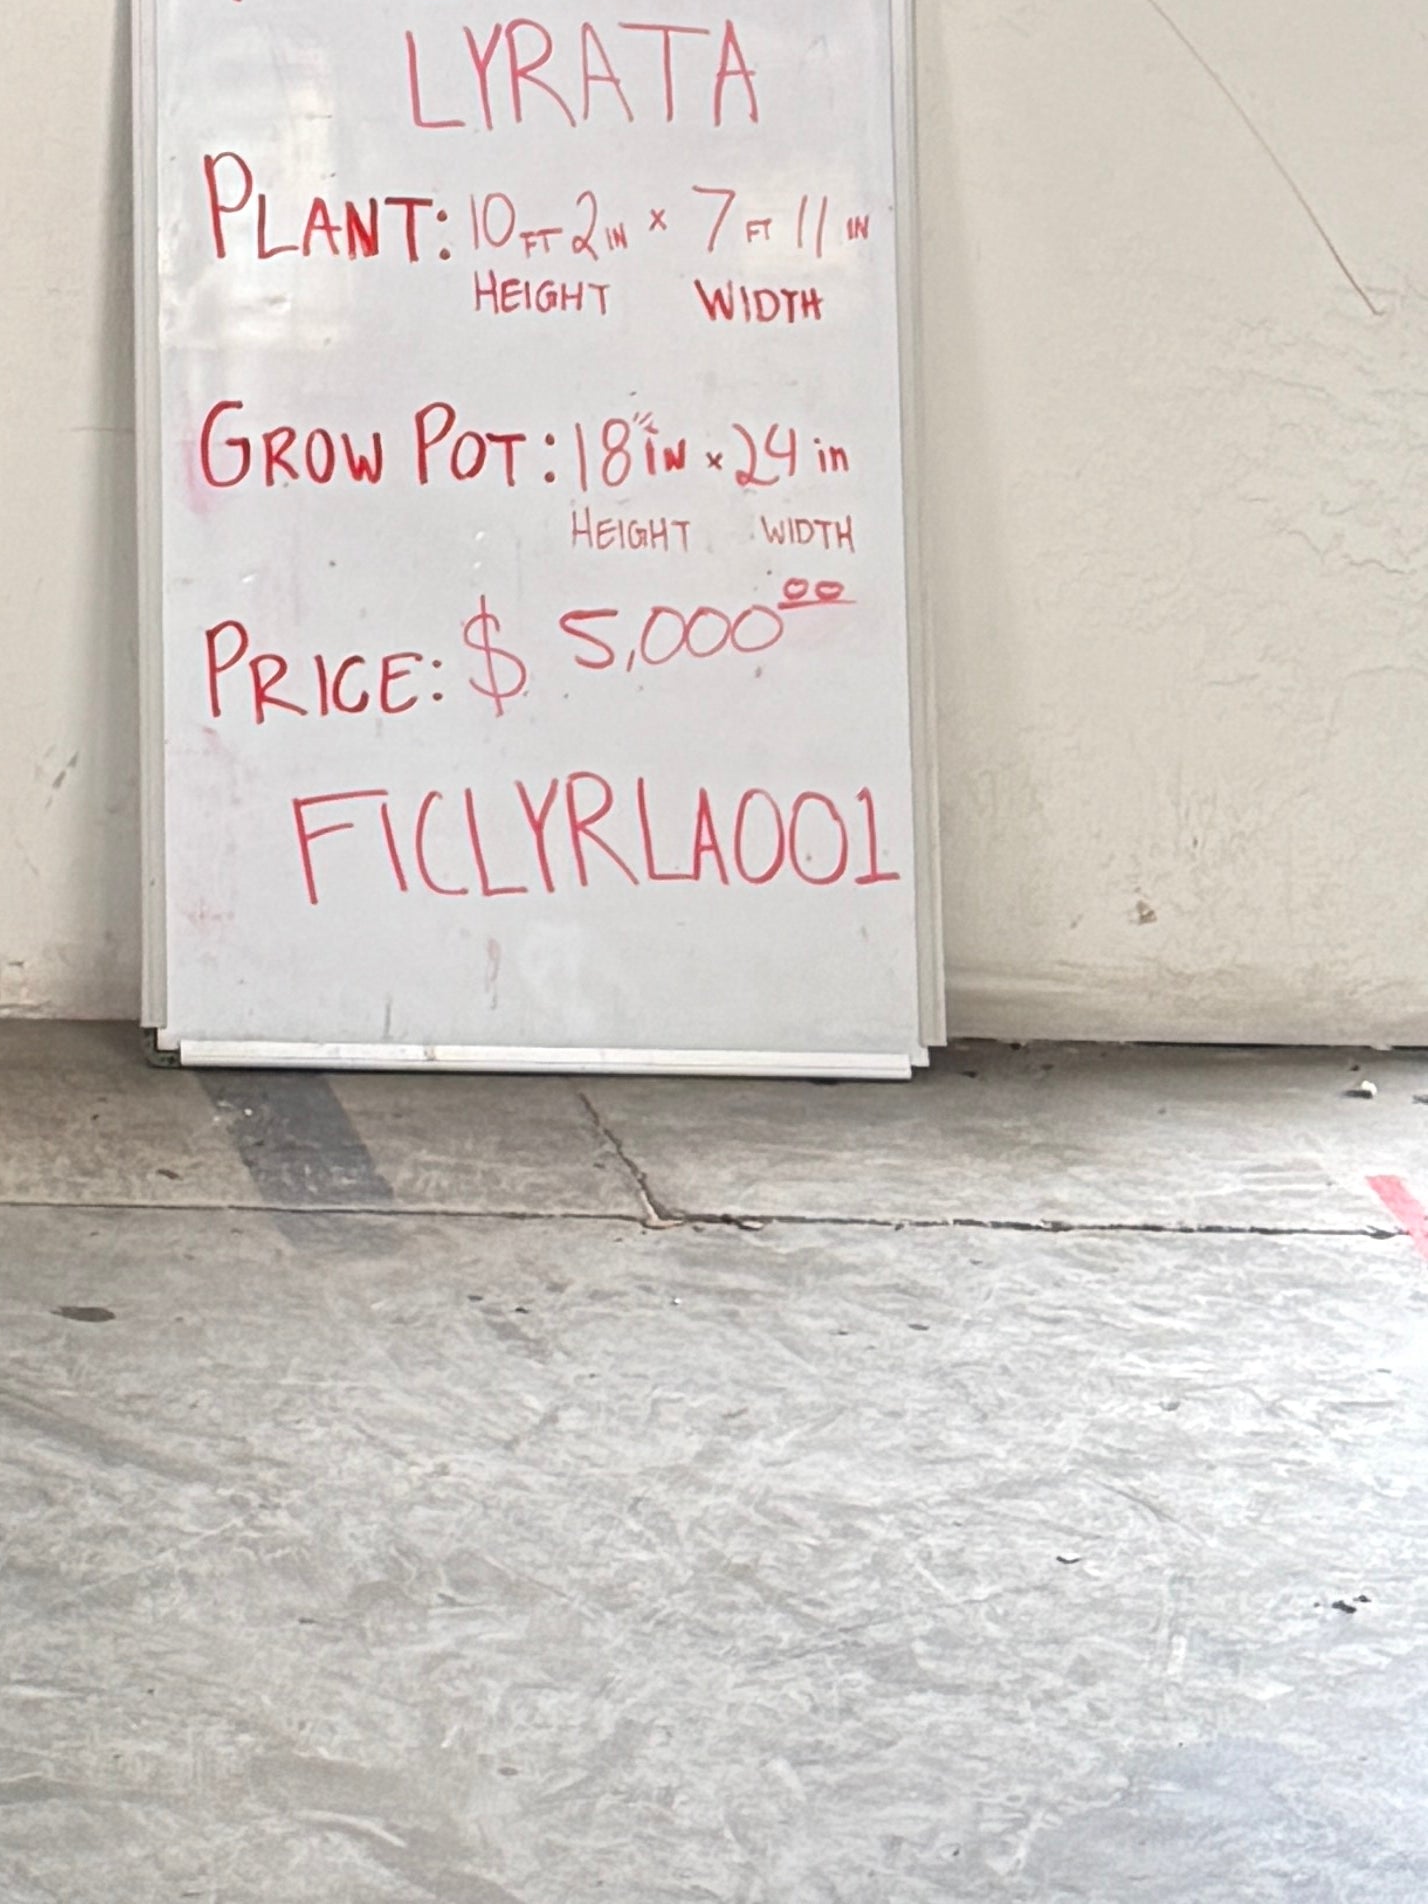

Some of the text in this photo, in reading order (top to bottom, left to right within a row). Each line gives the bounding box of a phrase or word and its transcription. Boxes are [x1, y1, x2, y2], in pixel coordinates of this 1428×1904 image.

[405, 18, 760, 129] LYRATA
[473, 269, 824, 324] HEIGHT WIDTH
[198, 400, 384, 489] GROW
[571, 506, 856, 554] HEIGHT WIDTH
